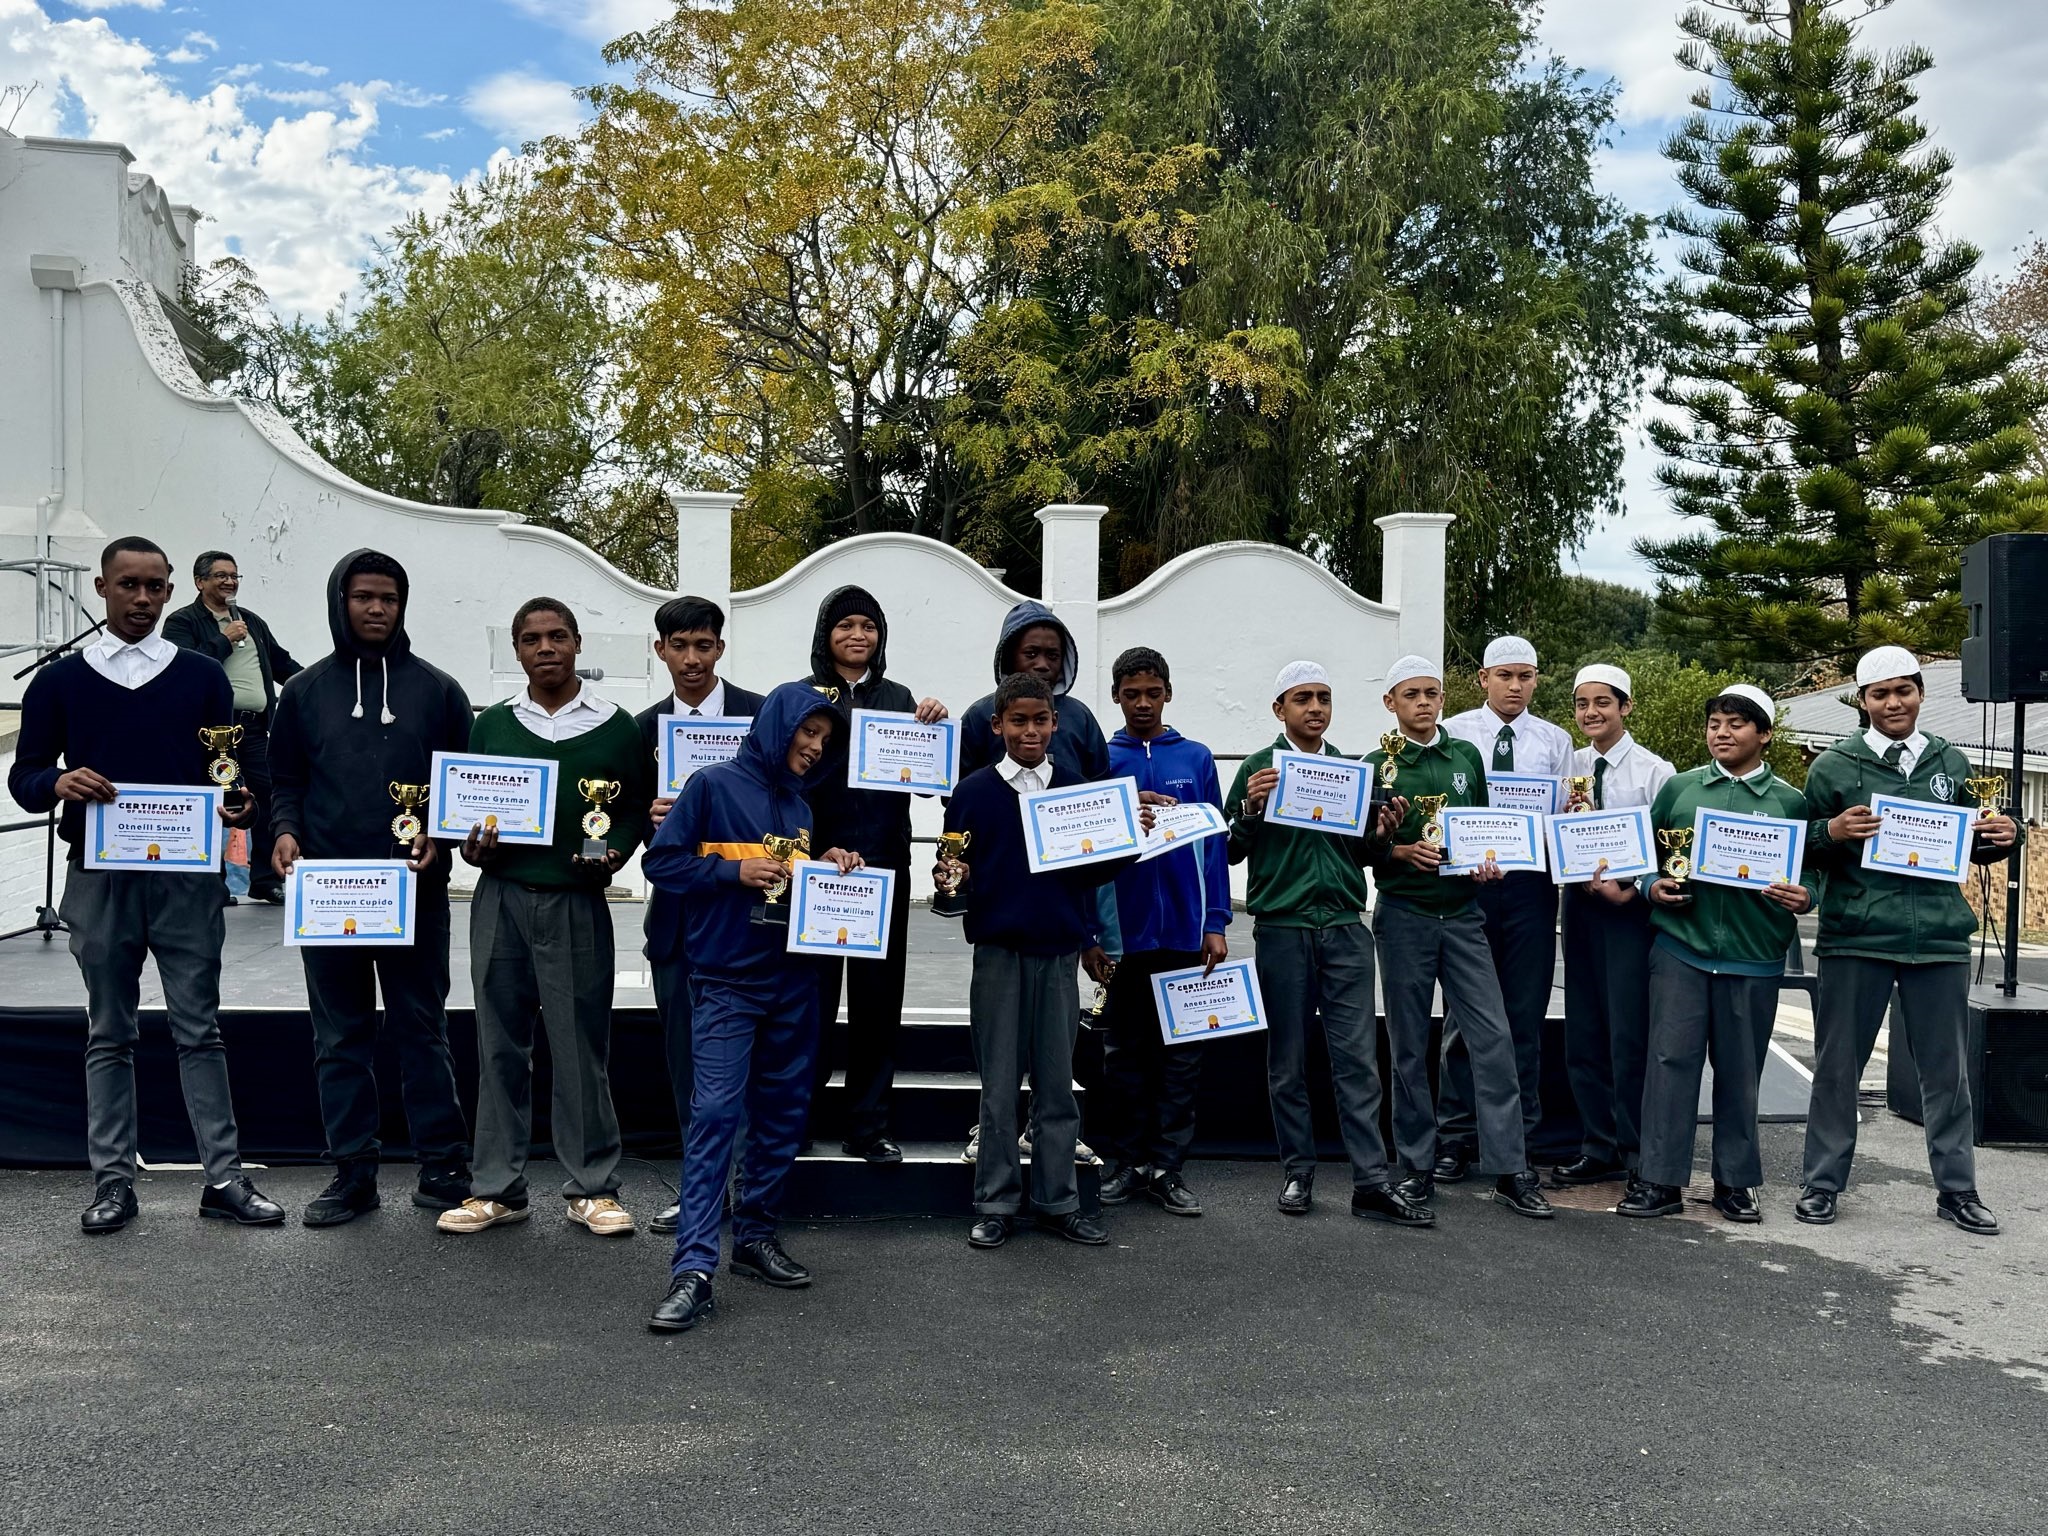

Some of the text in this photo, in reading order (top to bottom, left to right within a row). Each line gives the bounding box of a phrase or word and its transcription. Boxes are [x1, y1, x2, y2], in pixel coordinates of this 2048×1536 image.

[878, 729, 937, 740] CERTIFICATE
[904, 749, 934, 758] Bantam
[460, 773, 529, 783] CERTIFICATE
[1297, 768, 1350, 781] CERTIFICATE
[457, 793, 529, 804] Tyrone Gysman
[118, 802, 192, 811] CERTIFICATE
[1049, 798, 1111, 813] CERTIFICATE
[1050, 822, 1081, 833] Damian
[1084, 817, 1117, 827] Charles
[1892, 814, 1948, 827] CERTIFICATE
[1570, 824, 1627, 833] CERTIFICATE
[1718, 827, 1779, 840] CERTIFICATE
[1712, 844, 1746, 853] Abubakr
[819, 882, 874, 894] CERTIFICATE
[813, 904, 874, 916] Joshua Williams
[1178, 978, 1234, 991] CERTIFICATE
[1210, 995, 1235, 1004] Jacobs
